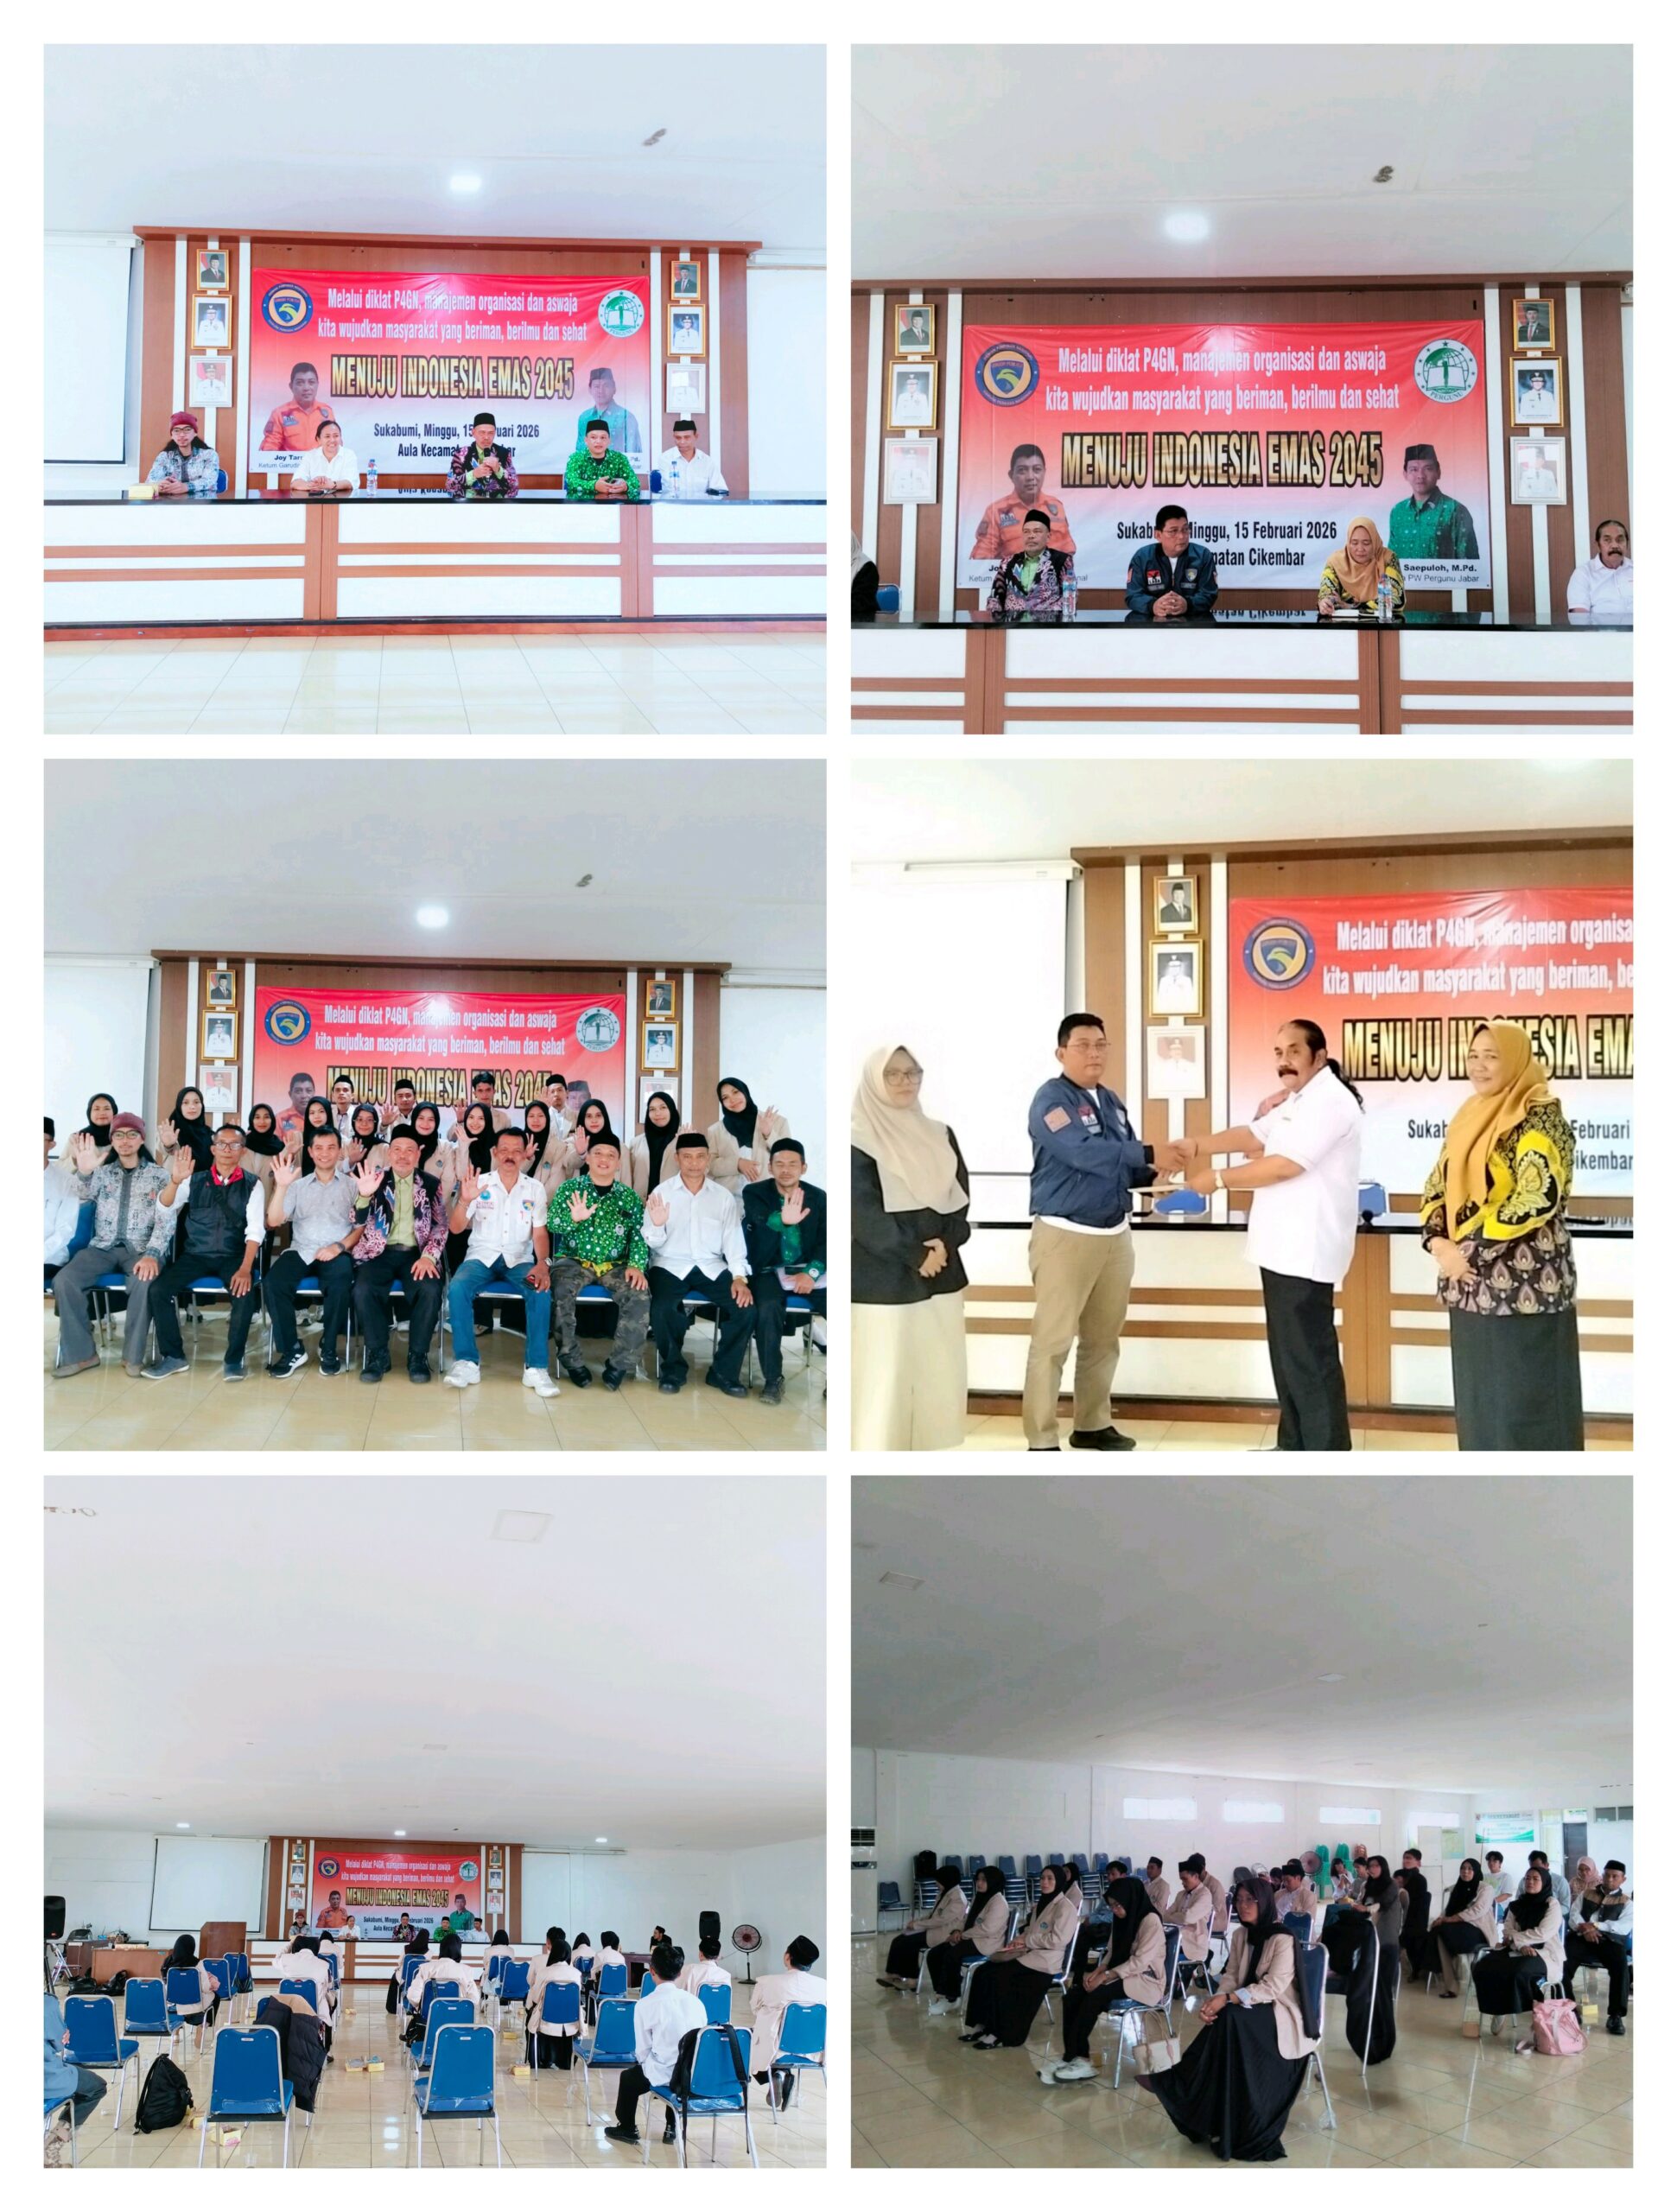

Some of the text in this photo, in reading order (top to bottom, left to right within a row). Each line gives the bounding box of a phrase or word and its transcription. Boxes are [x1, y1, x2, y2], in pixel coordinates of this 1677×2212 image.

[328, 289, 363, 308] Melalui
[365, 289, 391, 309] diklat
[394, 290, 422, 313] P4GN,
[425, 292, 475, 315] manajemen
[479, 292, 525, 315] organisasi
[527, 292, 544, 312] dan
[547, 293, 578, 316] aswaja
[318, 318, 336, 337] kita
[339, 318, 382, 342] wujudkan
[385, 320, 438, 344] masyarakat
[441, 323, 461, 343] yang
[465, 321, 505, 342] beriman,
[506, 321, 540, 341] berilmu
[543, 321, 560, 341] dan
[562, 322, 588, 342] sehat
[1058, 347, 1102, 373] Melalui
[1106, 347, 1140, 372] diklat
[1143, 346, 1178, 376] P4GN,
[1182, 347, 1249, 377] manajemen
[1254, 346, 1315, 377] organisasi
[1318, 346, 1340, 372] dan
[1344, 345, 1386, 377] aswaja
[330, 354, 574, 400] MENUJU INDONESIA EMAS 2045
[1045, 385, 1068, 411] kita
[1072, 385, 1128, 416] wujudkan
[1132, 385, 1201, 416] masyarakat
[1204, 389, 1232, 416] yang
[1236, 384, 1287, 414] beriman,
[1292, 384, 1336, 410] berilmu
[1340, 384, 1362, 410] dan
[1366, 384, 1400, 410] sehat
[1431, 391, 1464, 401] PERGUNU
[374, 423, 422, 439] Sukabumi,
[423, 423, 460, 439] Minggu,
[517, 424, 539, 437] 2026
[398, 442, 418, 457] Aula
[1061, 430, 1383, 488] MENUJU INDONESIA EMAS 2045
[1235, 522, 1249, 539] 15
[1253, 522, 1303, 539] Februari
[1306, 522, 1337, 539] 2026
[1249, 548, 1305, 566] Cikembar
[969, 574, 992, 582] Ketum
[1403, 563, 1450, 573] Saepuloh,
[1424, 574, 1457, 583] Pergunu
[1458, 574, 1479, 582] Jabar
[1337, 921, 1388, 950] Melalui
[1392, 919, 1432, 950] diklat
[1436, 917, 1481, 950] P4GN,
[1571, 912, 1633, 950] organisa
[1323, 965, 1350, 995] kita
[1353, 963, 1420, 1001] wujudkan
[1424, 961, 1506, 999] masyarakat
[1509, 965, 1545, 997] yang
[1548, 959, 1614, 993] beriman,
[325, 1005, 356, 1023] Melalui
[359, 1006, 383, 1025] diklat
[385, 1007, 410, 1028] P4GN,
[463, 1008, 507, 1030] organisasi
[509, 1009, 525, 1027] dan
[527, 1009, 556, 1032] aswaja
[315, 1032, 332, 1051] kita
[334, 1033, 374, 1054] wujudkan
[377, 1034, 426, 1056] masyarakat
[428, 1037, 448, 1056] yang
[451, 1036, 486, 1056] beriman,
[489, 1037, 520, 1055] berilmu
[524, 1037, 539, 1056] dan
[542, 1037, 565, 1056] sehat
[1343, 1018, 1443, 1082] MENUJU
[1575, 1150, 1633, 1170] ikembar
[346, 1859, 360, 1869] Melalui
[361, 1859, 373, 1869] diklat
[408, 1861, 429, 1872] organisasi
[429, 1861, 437, 1870] dan
[437, 1863, 451, 1872] aswaja
[350, 1872, 369, 1882] wujudkan
[370, 1873, 392, 1884] masyarakat
[392, 1874, 403, 1884] yang
[444, 1875, 454, 1884] sehat
[346, 1887, 449, 1908] MENUJU INDONESIA EMAS 2045
